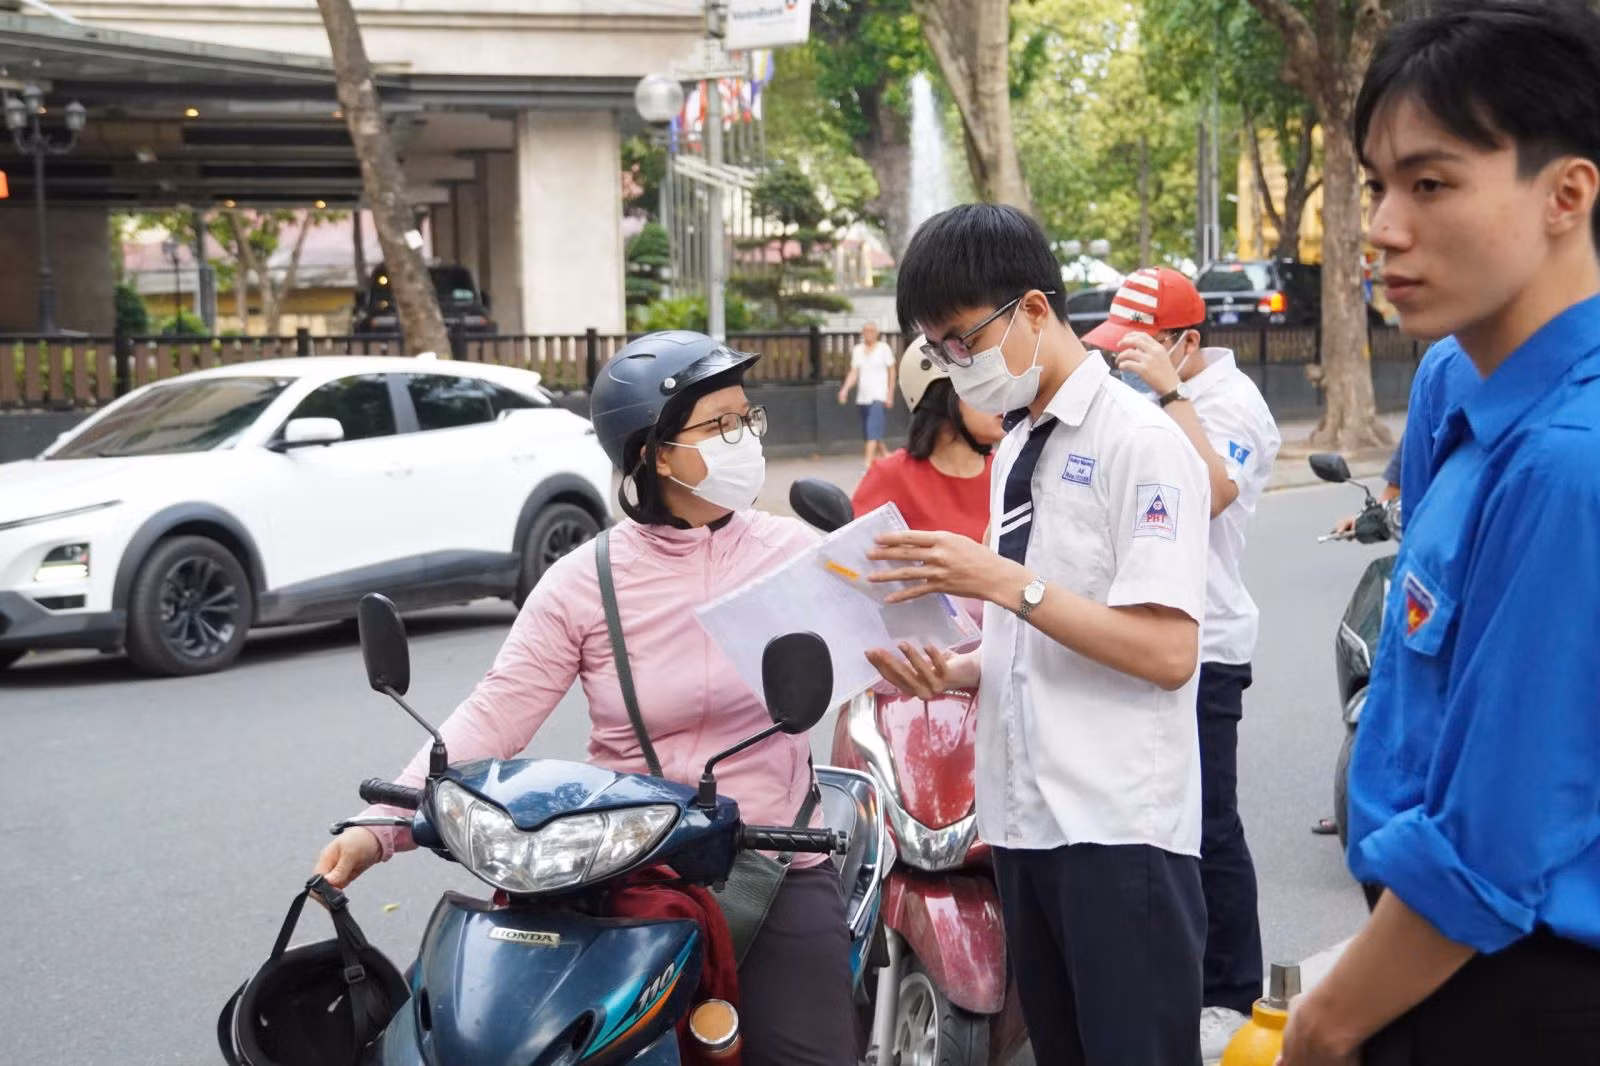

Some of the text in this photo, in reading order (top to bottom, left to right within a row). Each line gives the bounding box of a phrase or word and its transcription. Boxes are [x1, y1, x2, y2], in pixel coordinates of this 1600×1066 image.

[1146, 513, 1167, 523] PHT
[494, 930, 553, 942] HONDA
[637, 962, 675, 1015] 110
